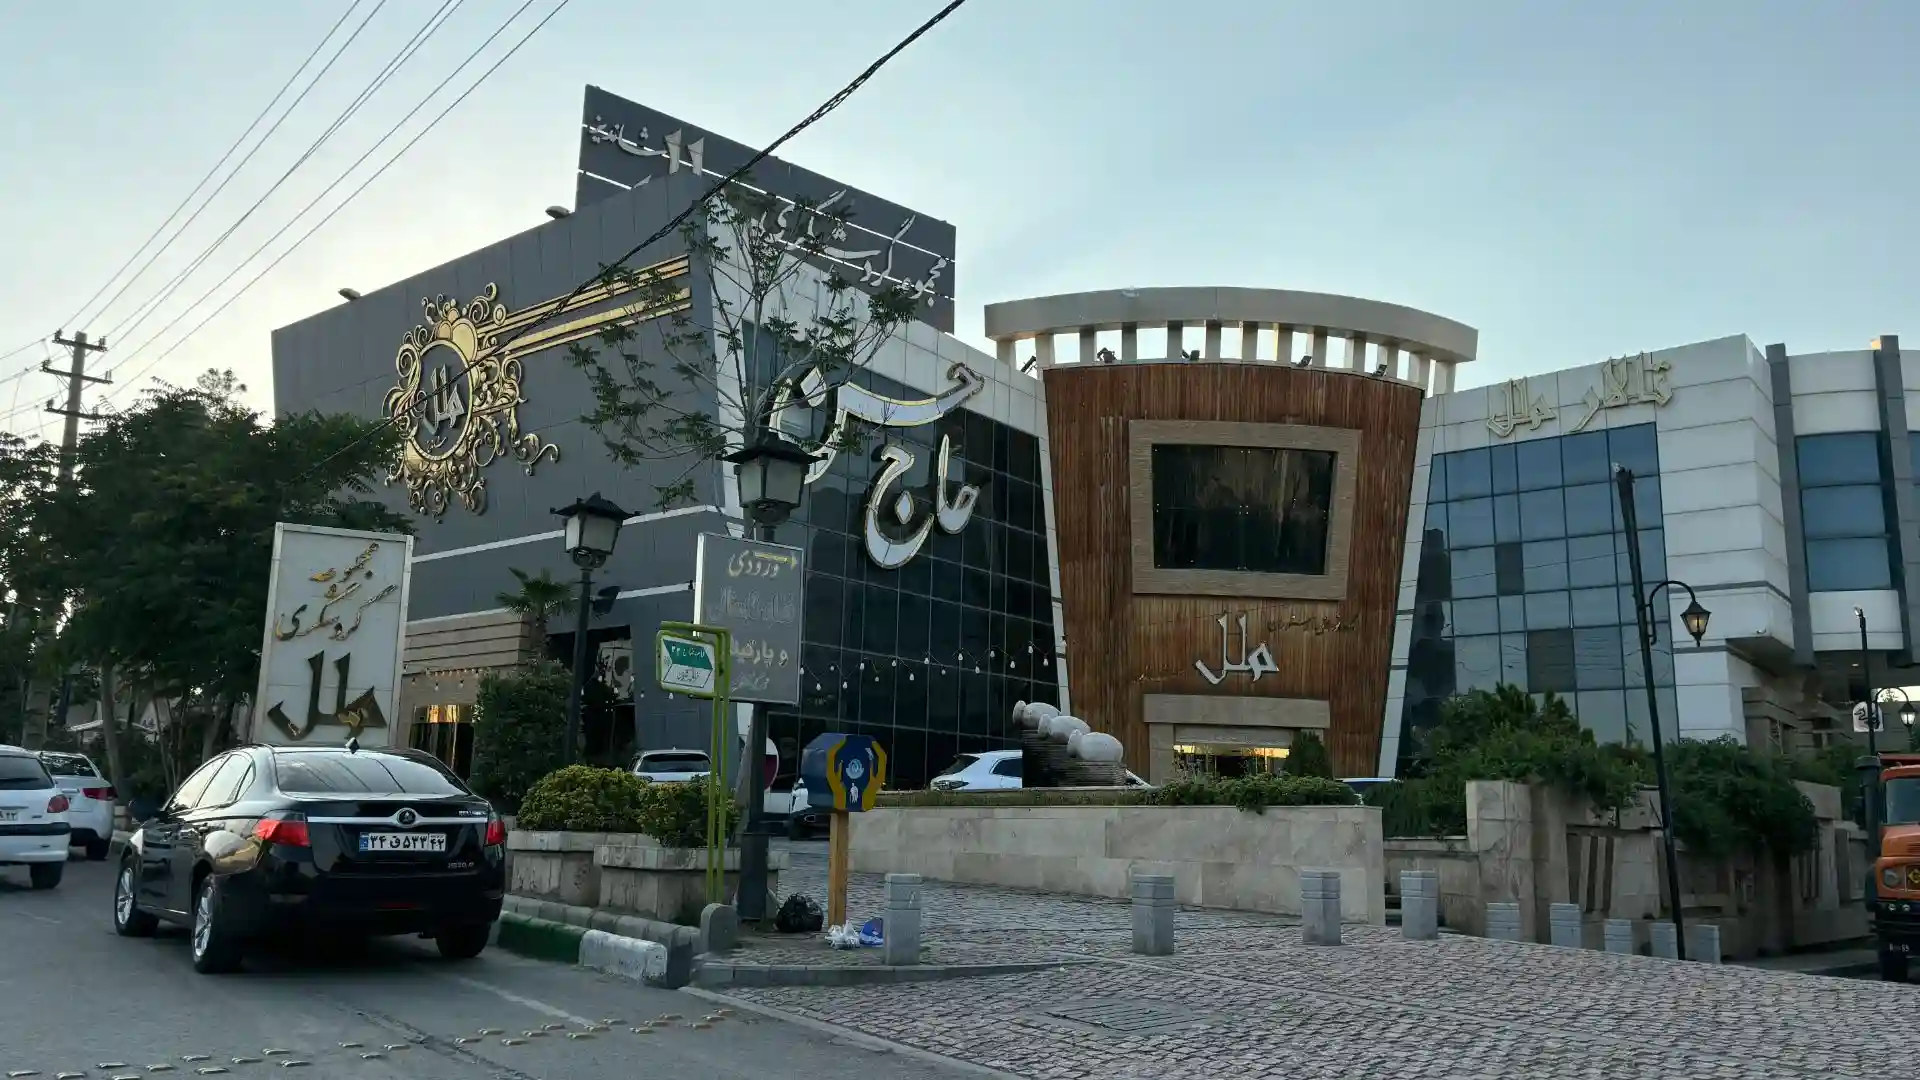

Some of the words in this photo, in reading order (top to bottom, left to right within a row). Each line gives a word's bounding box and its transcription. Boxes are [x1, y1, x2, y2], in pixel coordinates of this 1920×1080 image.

[1486, 376, 1556, 438] ملل
[726, 549, 780, 578] ورودی
[1195, 612, 1280, 685] ملل
